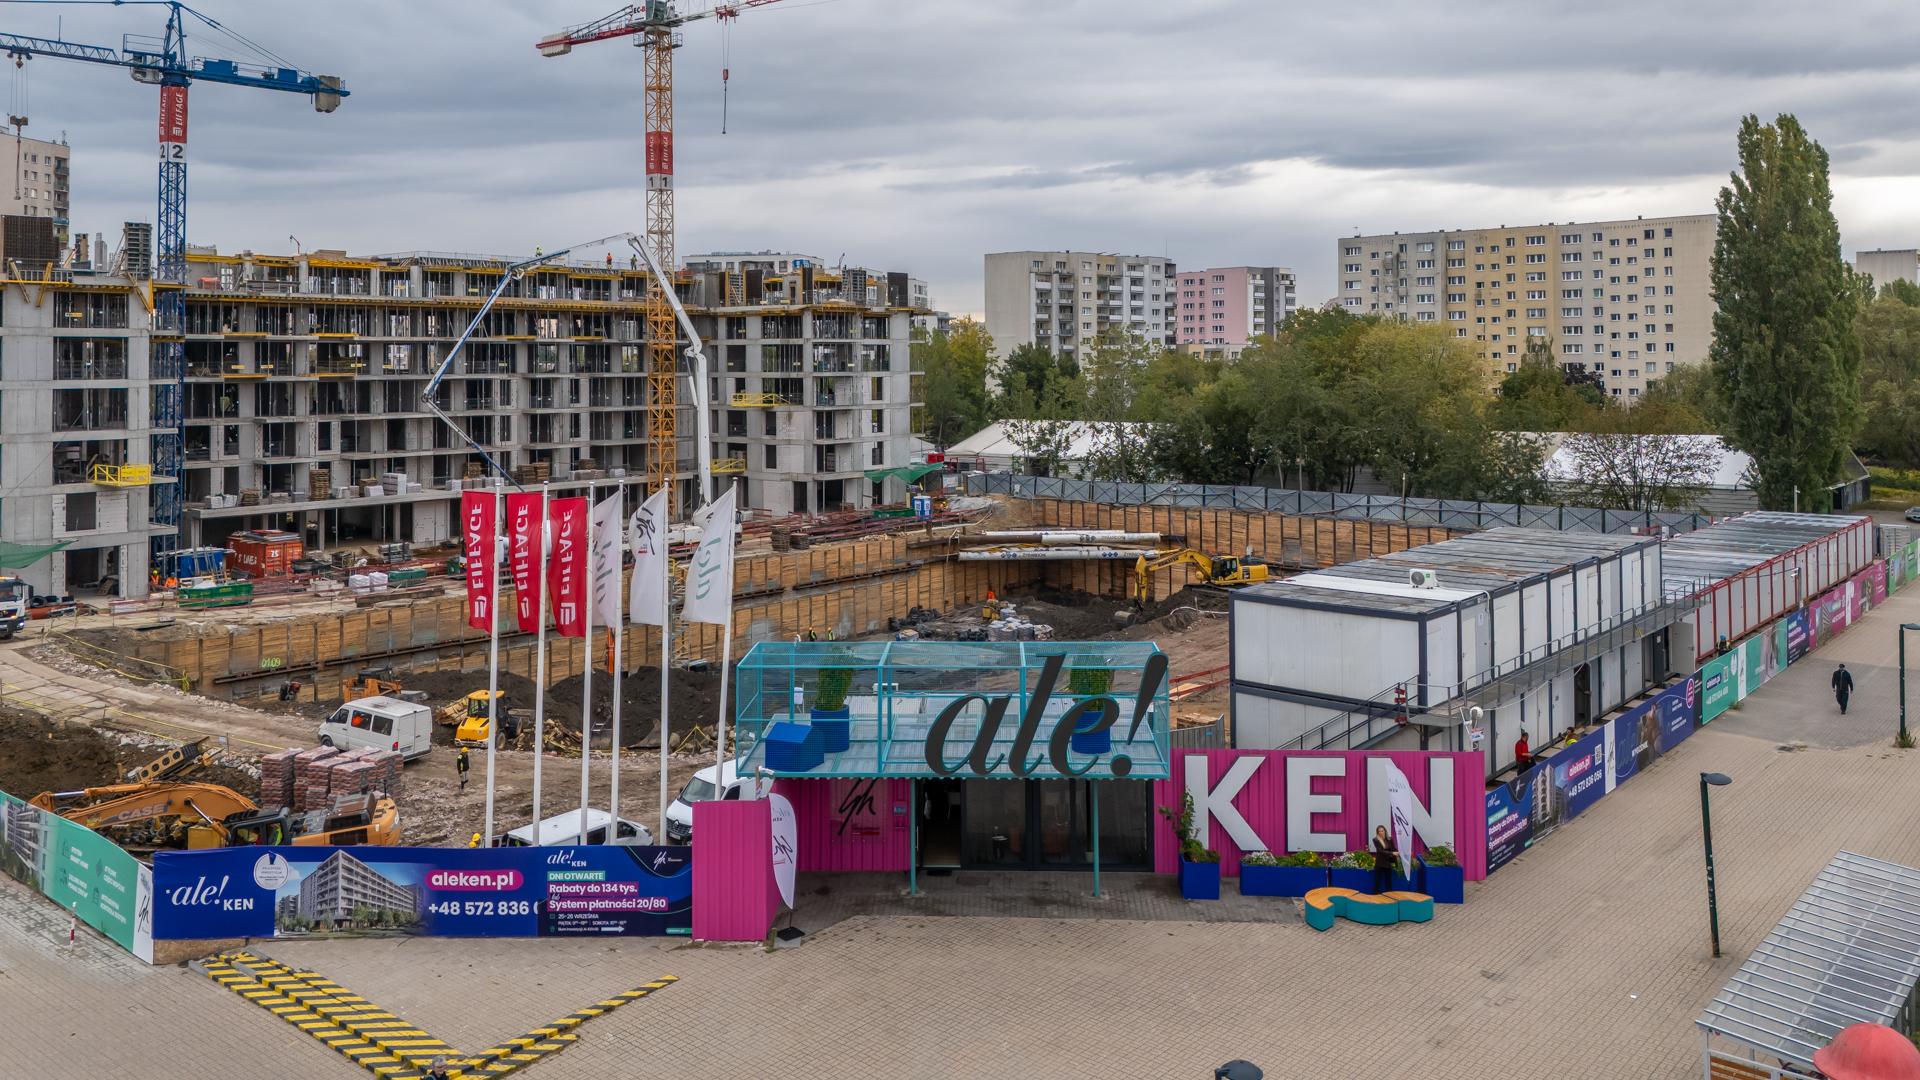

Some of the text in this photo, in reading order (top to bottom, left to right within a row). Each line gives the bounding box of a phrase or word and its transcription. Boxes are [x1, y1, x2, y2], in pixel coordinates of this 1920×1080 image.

[175, 92, 184, 126] EIFFAGE
[160, 144, 166, 159] 2
[172, 144, 184, 159] 2
[649, 176, 654, 188] 1
[662, 176, 668, 188] 1
[925, 651, 1169, 777] ale!
[1184, 755, 1455, 853] KEN
[118, 804, 163, 820] CASE
[546, 849, 575, 865] ale!
[431, 871, 514, 891] aleken.pl
[549, 872, 604, 881] DNI OTWARTE
[171, 874, 254, 911] ale! KEN
[549, 883, 638, 896] Rabaty do 134 tys.
[428, 902, 461, 915] +48
[464, 901, 495, 915] 572
[497, 901, 530, 915] 836
[549, 899, 588, 911] System
[589, 898, 636, 911] płatności
[636, 897, 666, 910] 20/80
